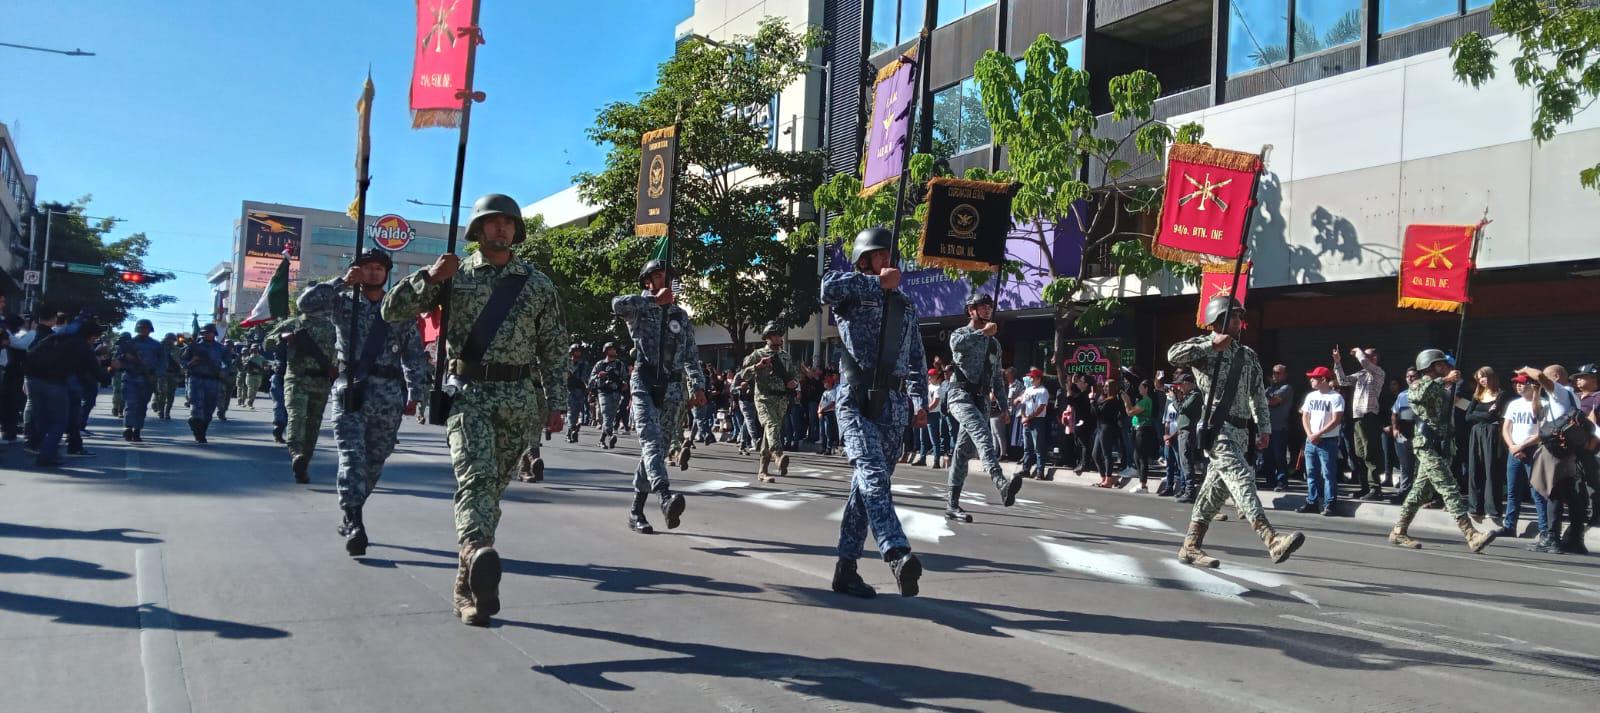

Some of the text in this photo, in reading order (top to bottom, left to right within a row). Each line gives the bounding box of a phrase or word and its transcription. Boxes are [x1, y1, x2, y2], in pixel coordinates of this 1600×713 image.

[368, 225, 416, 240] Waldo's
[1192, 226, 1208, 239] BTN.
[908, 273, 948, 286] TUS LENTES
[1067, 364, 1105, 374] LENTES EN
[1309, 399, 1331, 412] SMN
[1512, 411, 1537, 425] SMN
